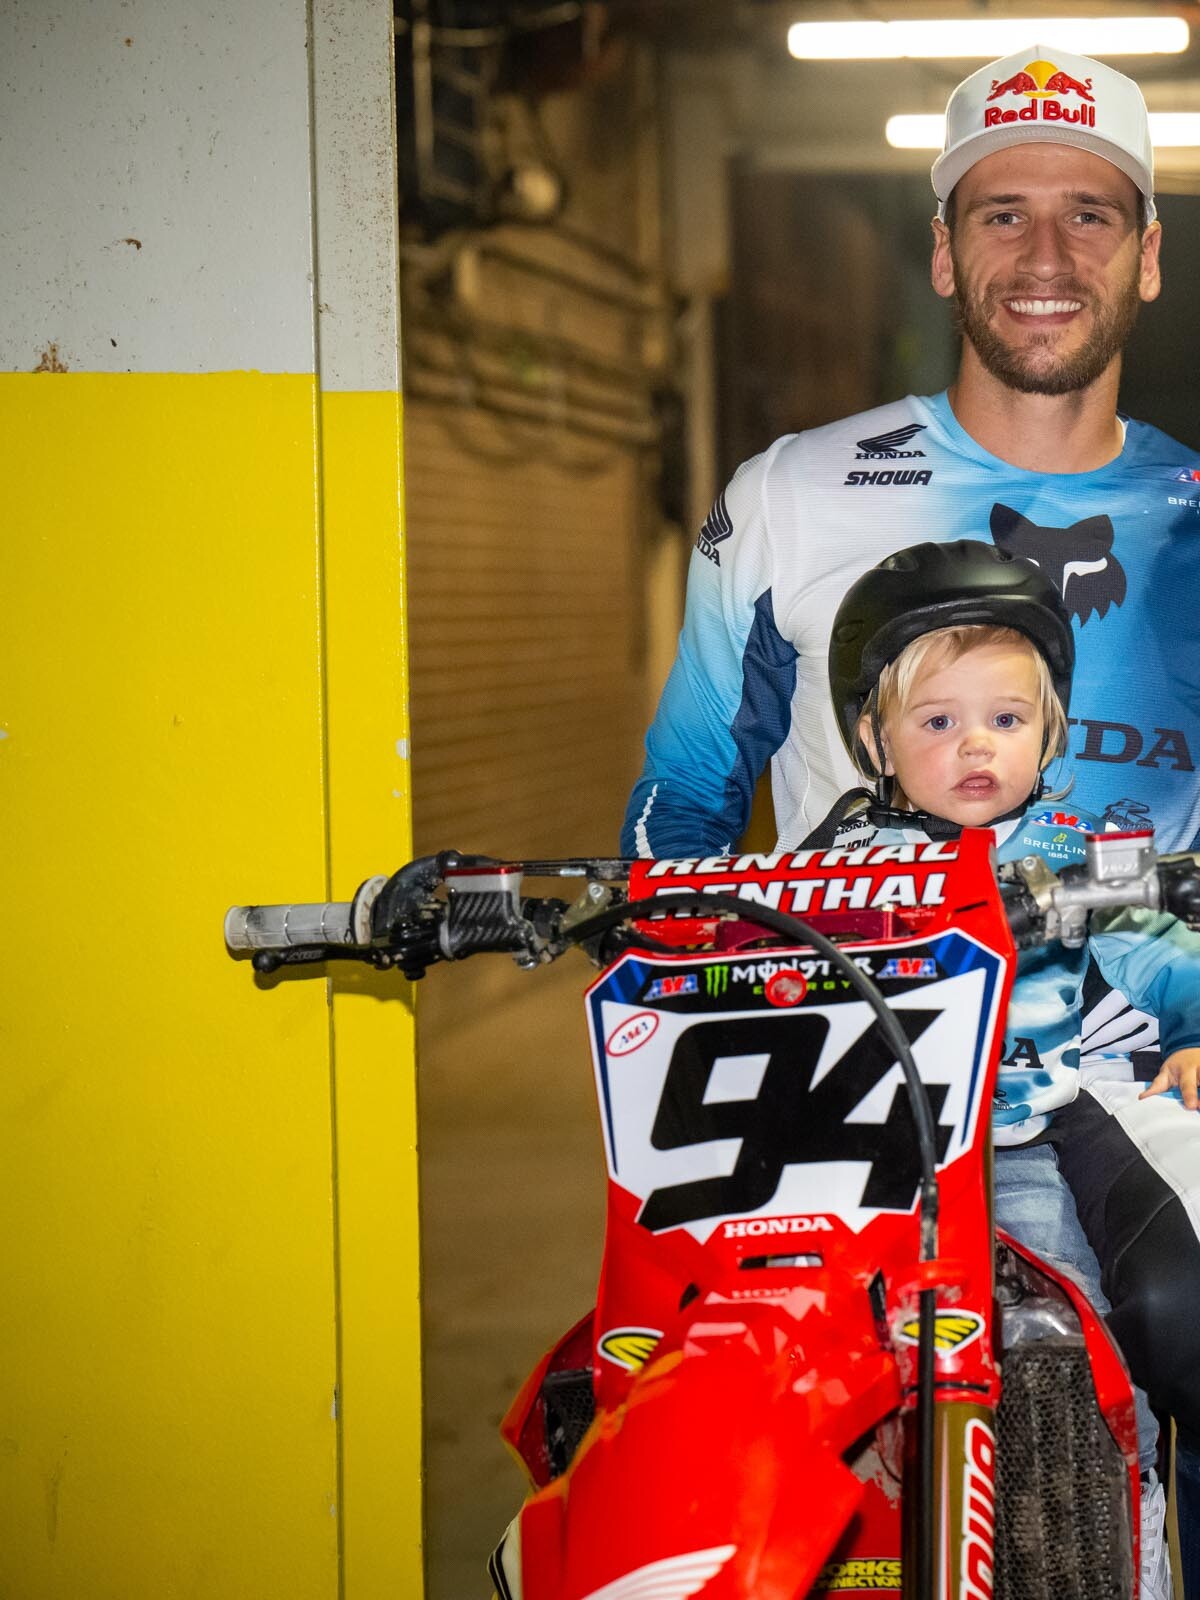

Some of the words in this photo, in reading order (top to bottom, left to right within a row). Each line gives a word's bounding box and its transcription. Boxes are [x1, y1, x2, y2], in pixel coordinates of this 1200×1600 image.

[985, 99, 1038, 128] Red
[1043, 101, 1096, 128] Bull
[854, 450, 927, 460] HONDA
[843, 470, 933, 486] SHOWA
[834, 820, 871, 836] HOND
[1031, 811, 1095, 834] AMA
[1023, 836, 1087, 856] BREITLIN
[1047, 851, 1069, 860] 1884
[647, 841, 959, 878] RENTHAL
[732, 957, 875, 984] MONSTR
[876, 957, 938, 979] AMA
[643, 974, 698, 1001] AMA
[752, 980, 851, 995] ERGY
[635, 1008, 955, 1232] 94
[723, 1216, 834, 1239] HONDA
[824, 1560, 902, 1577] ORKS
